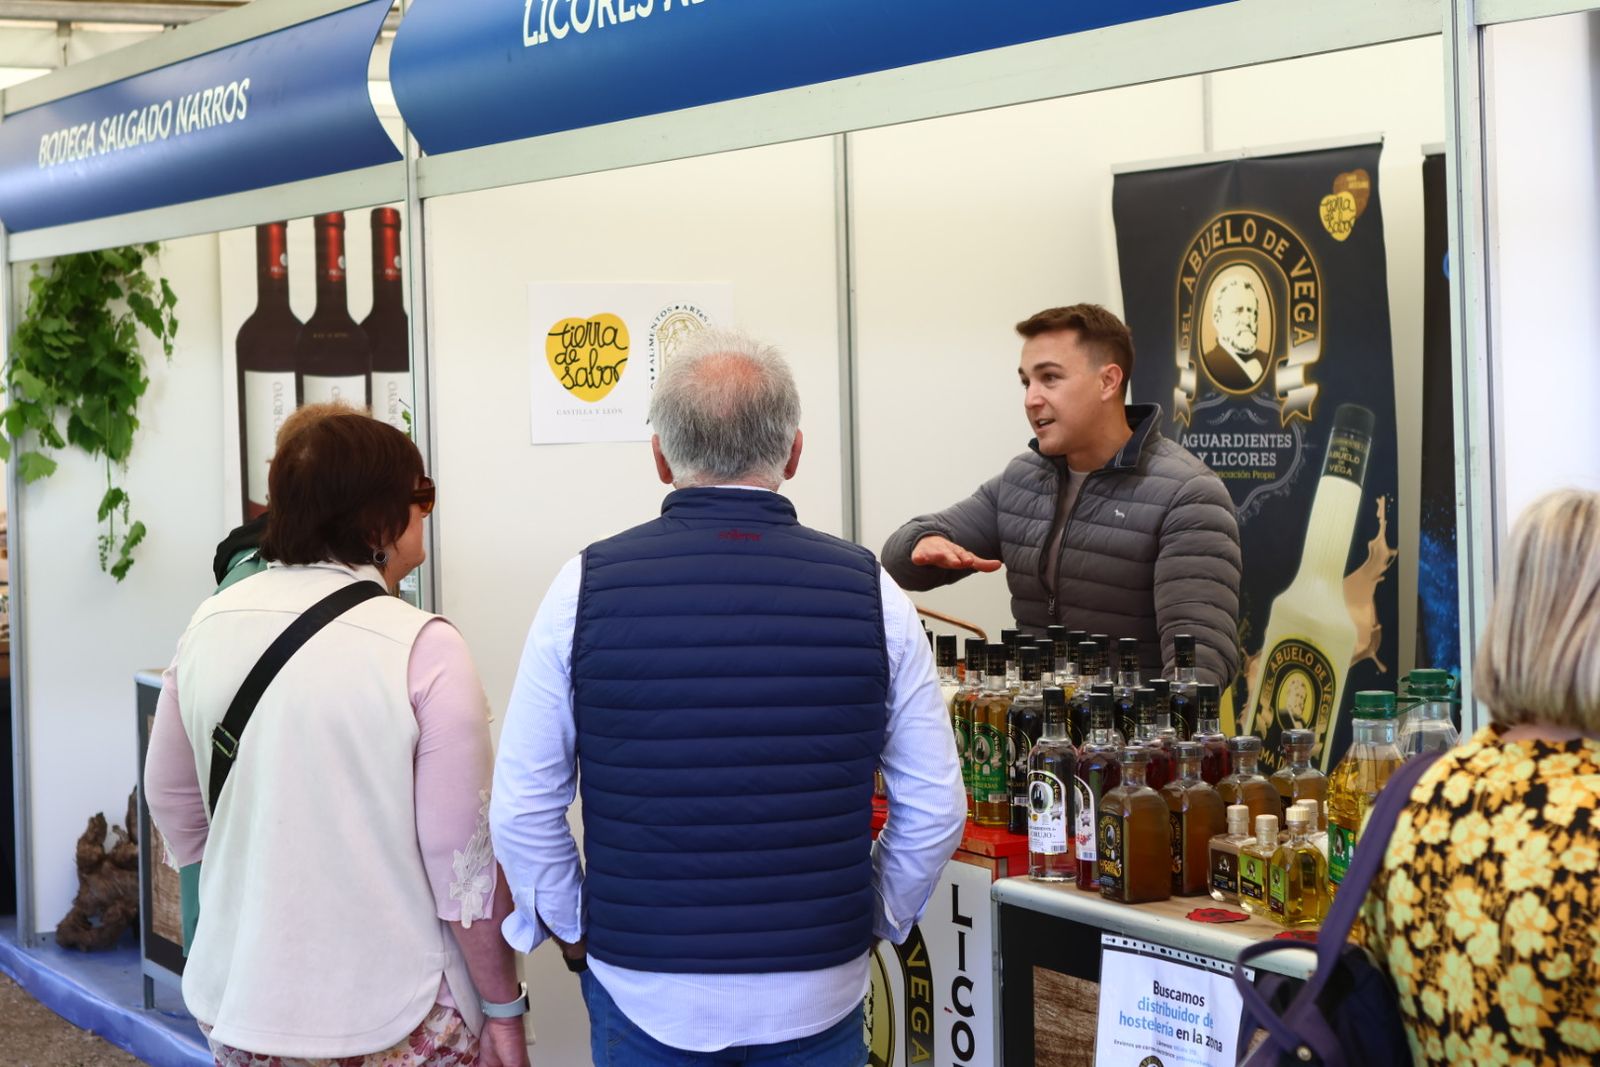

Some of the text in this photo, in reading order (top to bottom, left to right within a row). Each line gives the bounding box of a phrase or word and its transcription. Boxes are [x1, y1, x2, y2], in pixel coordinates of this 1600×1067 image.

[38, 78, 250, 169] BODEGA SALGADO NARROS
[1180, 217, 1315, 350] DEL ABUELO DE VEGA
[548, 321, 628, 350] tierra
[554, 347, 580, 366] de
[561, 347, 628, 390] sabor
[556, 408, 593, 416] CASTILLA
[1181, 433, 1293, 448] AGUARDIENTES
[1212, 452, 1277, 466] LICORES
[1329, 464, 1353, 477] VEGA
[1270, 647, 1314, 673] ABUELO
[1314, 663, 1328, 681] DE
[951, 884, 976, 1067] LICO
[906, 941, 931, 1064] VEGA
[1153, 980, 1205, 1007] Buscamos
[1137, 996, 1214, 1030] distribuidor de
[1176, 1027, 1190, 1042] en
[1192, 1028, 1203, 1045] la
[1205, 1034, 1223, 1053] zona
